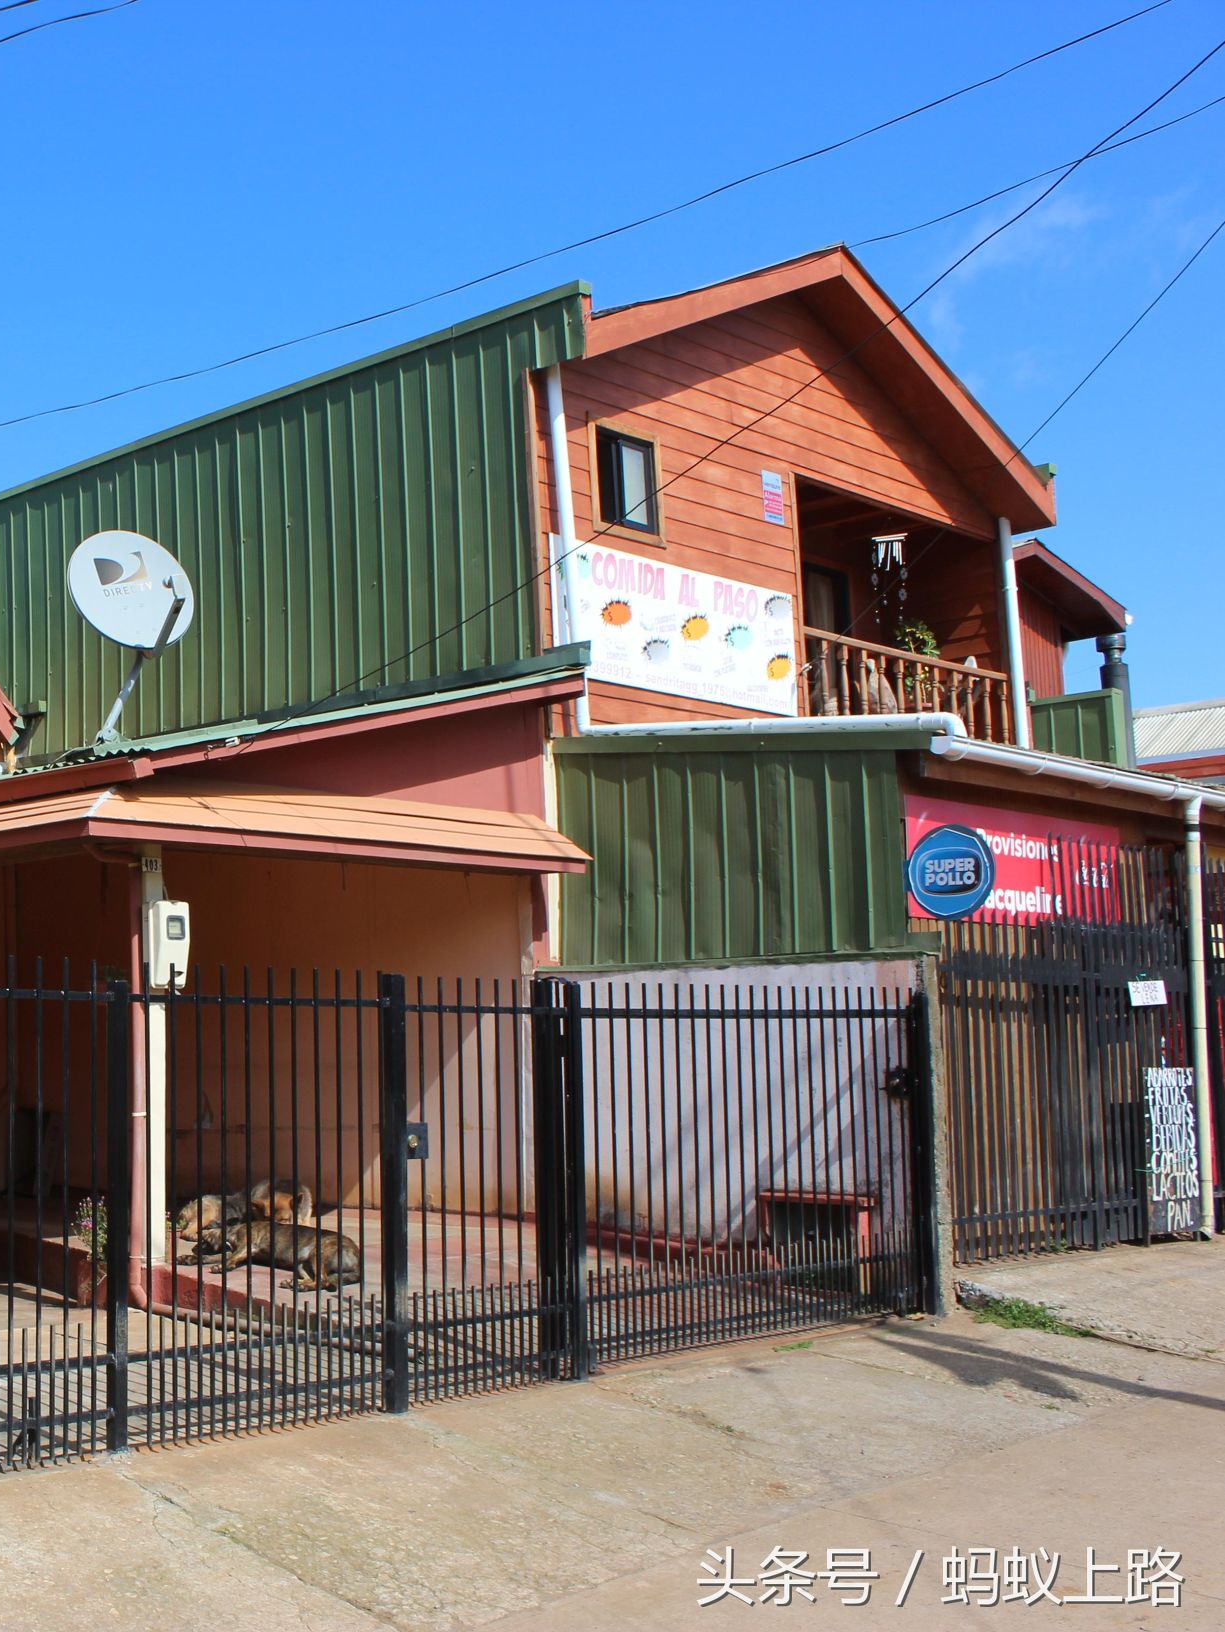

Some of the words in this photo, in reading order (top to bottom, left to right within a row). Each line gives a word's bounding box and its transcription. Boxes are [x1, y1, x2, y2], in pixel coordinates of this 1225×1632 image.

[591, 551, 665, 601] COMIDA
[678, 574, 699, 607] AL
[713, 581, 758, 622] PASO
[586, 660, 632, 681] 399912
[145, 858, 158, 871] 403
[925, 857, 975, 873] SUPER
[925, 871, 976, 887] POLLO
[981, 886, 1062, 917] acqueline
[1147, 1067, 1193, 1087] ABARROTES
[1152, 1170, 1199, 1201] LACTEOS
